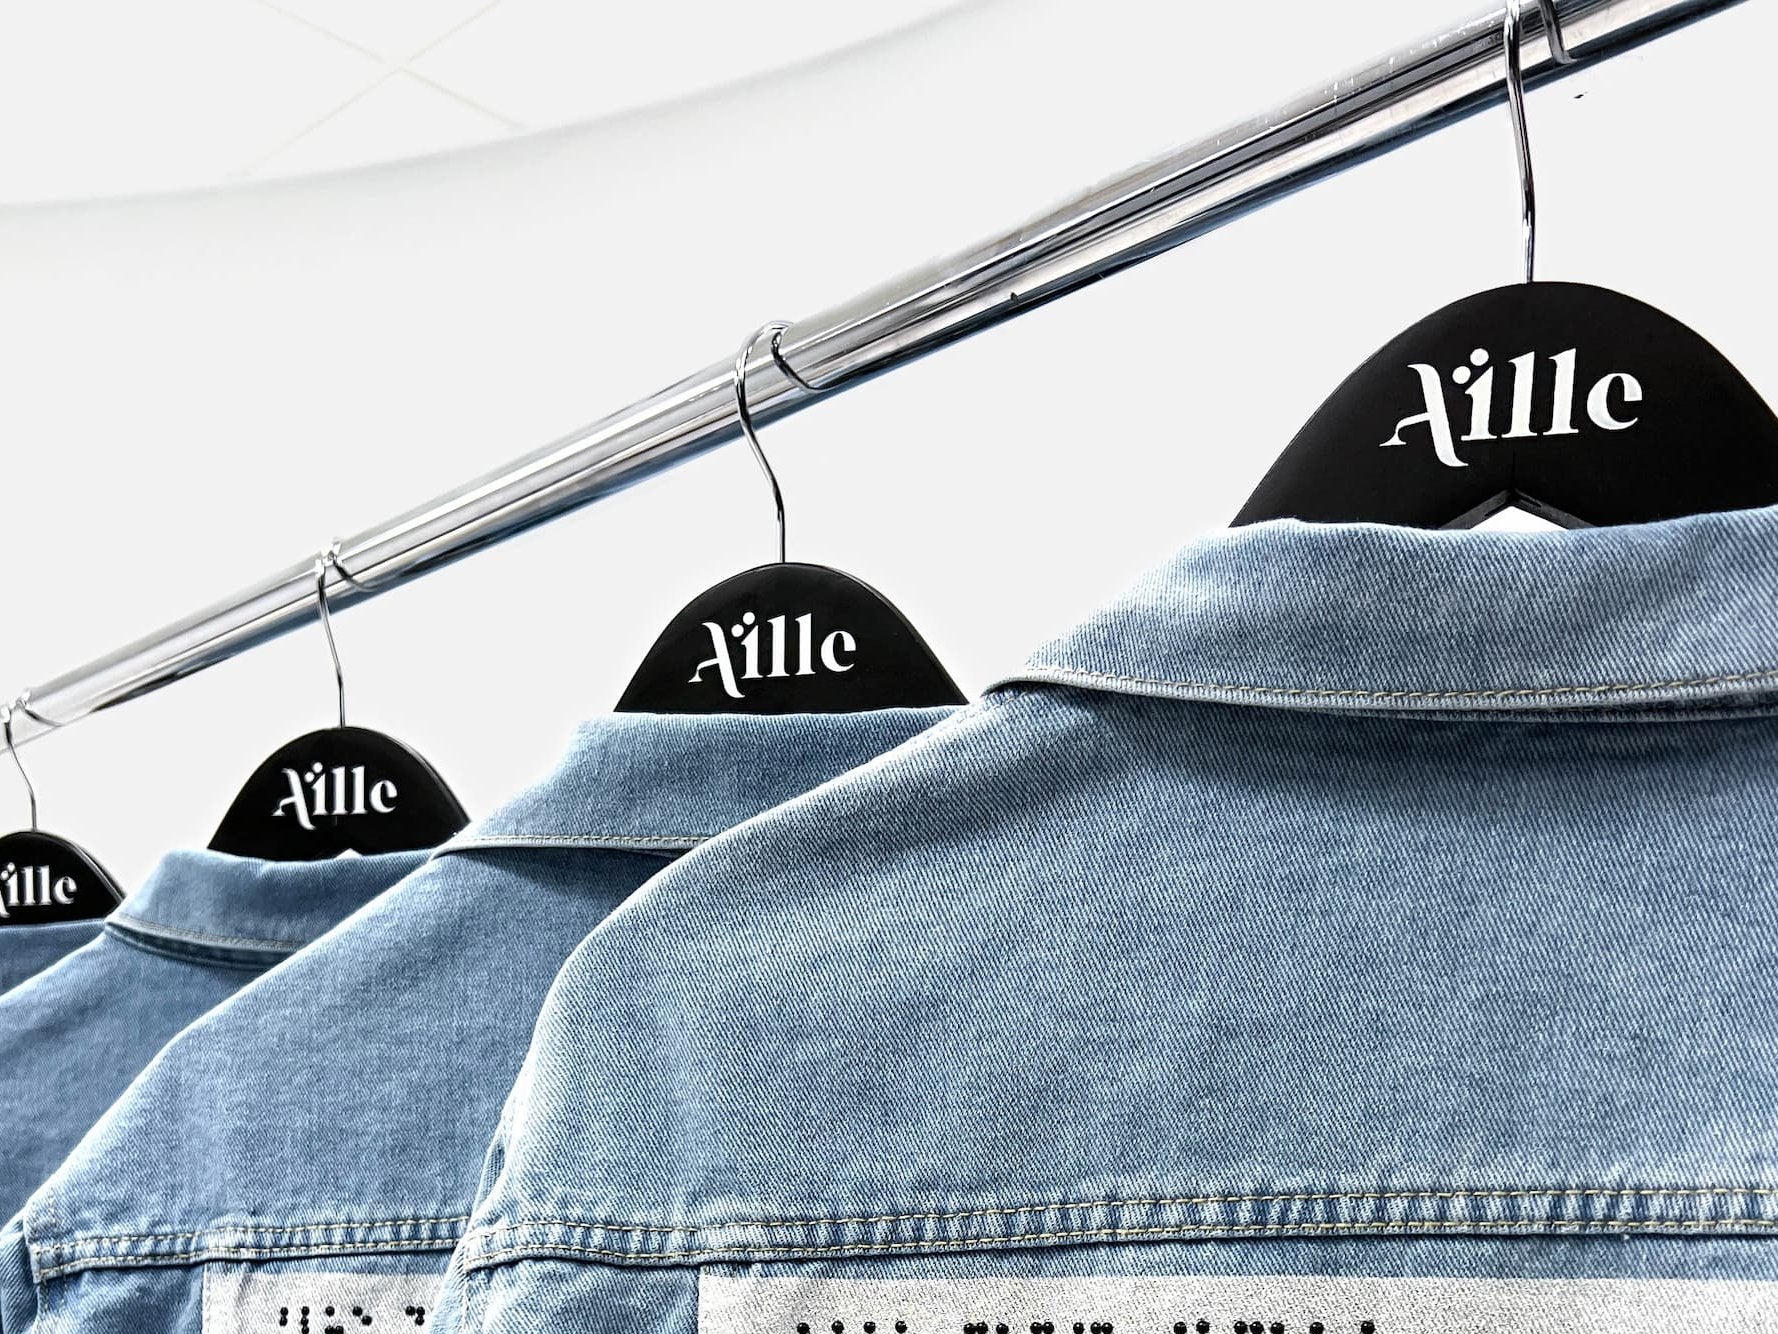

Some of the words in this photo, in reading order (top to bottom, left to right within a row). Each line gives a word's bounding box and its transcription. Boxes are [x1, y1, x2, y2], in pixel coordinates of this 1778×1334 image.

[1374, 339, 1643, 467] Aille
[688, 611, 857, 699] Aille
[272, 761, 398, 830] Aille
